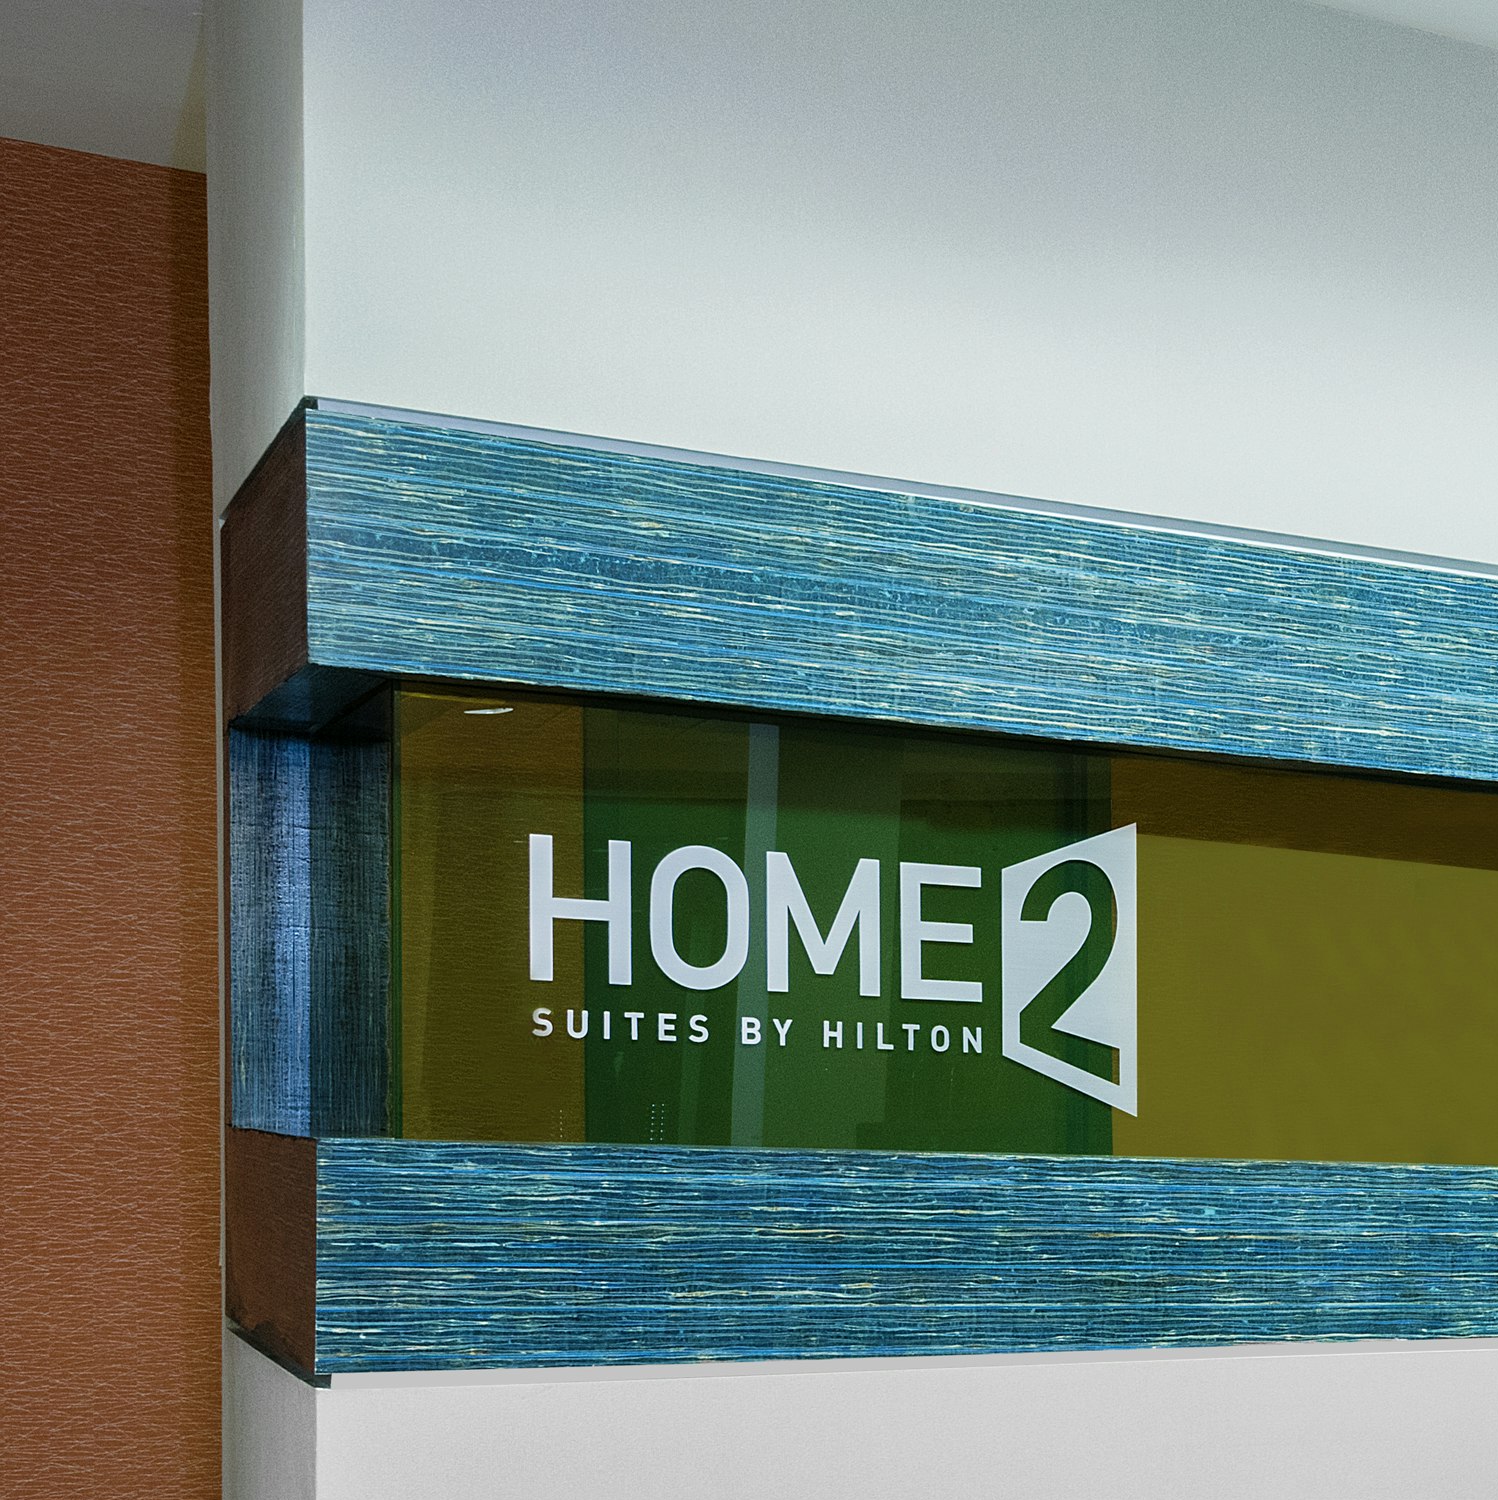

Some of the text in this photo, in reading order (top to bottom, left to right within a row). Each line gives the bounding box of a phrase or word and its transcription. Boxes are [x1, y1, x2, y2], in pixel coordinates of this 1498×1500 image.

[531, 1007, 984, 1055] SUITES BY HILTON
